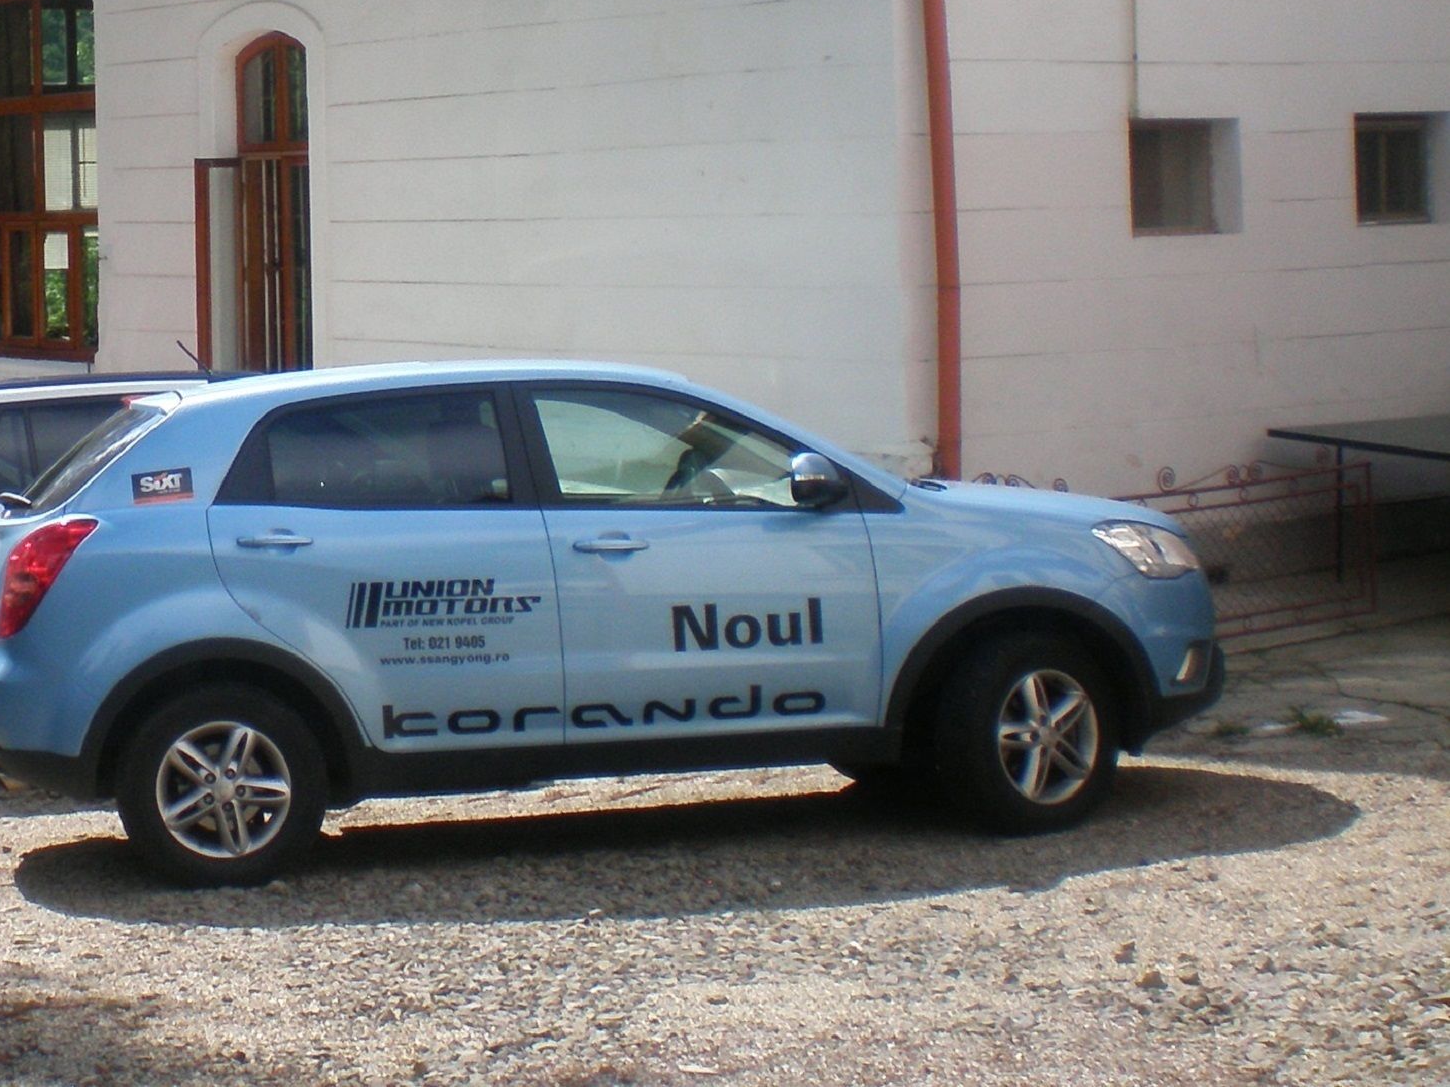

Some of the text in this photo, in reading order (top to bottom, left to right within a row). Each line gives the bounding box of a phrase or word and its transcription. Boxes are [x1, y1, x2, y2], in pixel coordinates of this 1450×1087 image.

[385, 578, 495, 599] UNION
[382, 595, 541, 617] MOTORS
[380, 619, 404, 628] PART
[407, 618, 419, 627] OF
[422, 618, 444, 627] NEW
[480, 616, 515, 626] GROUP
[672, 597, 824, 653] Noul
[428, 636, 450, 650] 021
[455, 635, 485, 649] 9405
[382, 684, 827, 739] korando
